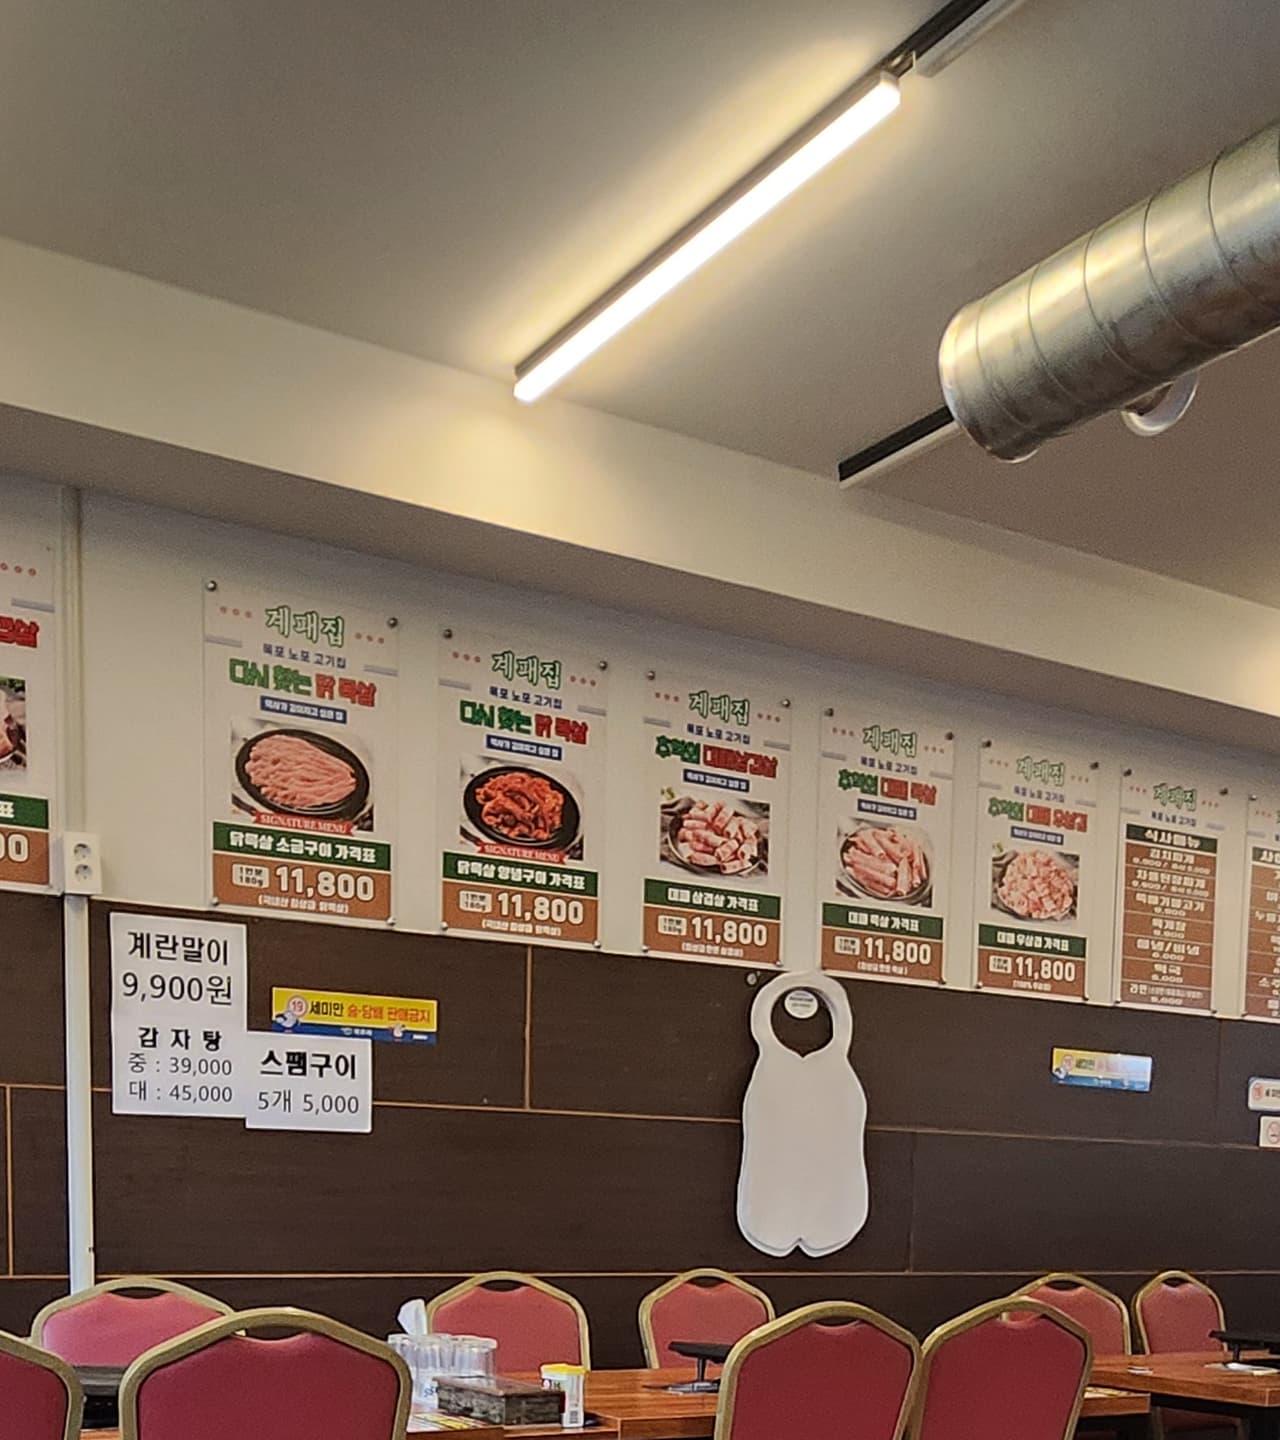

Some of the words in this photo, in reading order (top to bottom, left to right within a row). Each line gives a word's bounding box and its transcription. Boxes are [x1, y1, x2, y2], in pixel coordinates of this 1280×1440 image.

[265, 604, 344, 648] 계패집
[229, 657, 269, 689] 다시
[314, 652, 346, 669] 고기집
[491, 650, 561, 690] 계패집
[688, 690, 750, 727] 계패집
[862, 724, 918, 758] 계패집
[230, 831, 273, 851] 닭목살
[276, 836, 333, 858] 소금구이
[335, 844, 376, 864] 가격표
[275, 865, 375, 902] 11,800
[498, 865, 547, 885] 양념구이
[549, 872, 586, 890] 가격표
[497, 891, 584, 925] 11,800
[692, 890, 726, 908] 삼겹살
[727, 895, 759, 912] 가격표
[691, 916, 768, 947] 11,800
[890, 916, 919, 932] 가격표
[127, 931, 229, 966] 계란말이
[864, 937, 932, 965] 11,800
[1043, 936, 1069, 952] 가격표
[1015, 956, 1076, 982] 11,800
[121, 971, 232, 1007] 9,900원
[310, 1001, 344, 1018] 세미만
[127, 1052, 147, 1074] 중
[169, 1056, 233, 1078] 39,000
[260, 1048, 357, 1080] 스팸구이
[129, 1081, 147, 1101] 대
[169, 1084, 233, 1105] 45,000
[258, 1090, 293, 1114] 5개
[303, 1093, 360, 1116] 5,000
